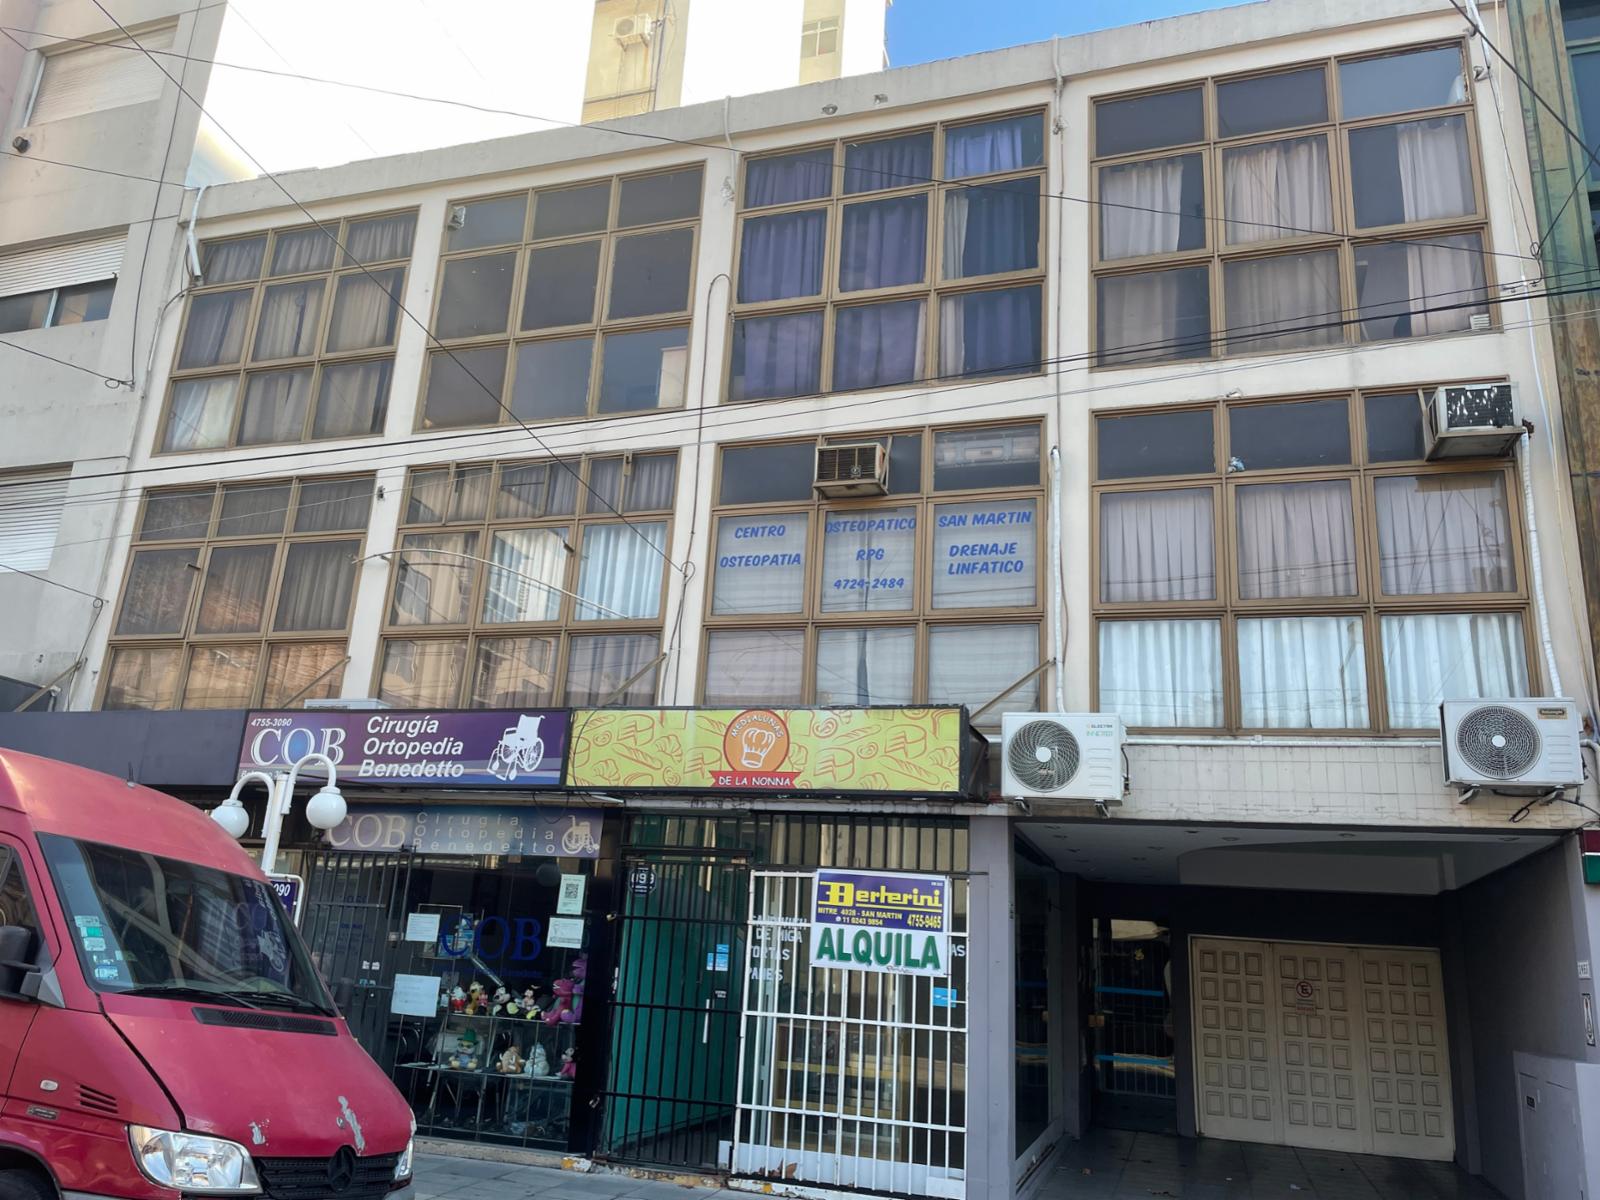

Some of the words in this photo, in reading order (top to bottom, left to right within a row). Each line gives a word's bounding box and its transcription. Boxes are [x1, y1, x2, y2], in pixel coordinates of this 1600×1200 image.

[735, 525, 785, 539] CENTRO
[825, 517, 916, 534] OSTEOPATICO
[938, 514, 967, 528] SAN
[972, 511, 1032, 526] MARTIN
[720, 553, 801, 568] OSTEOPATIA
[856, 549, 884, 561] RPG
[949, 542, 1018, 557] DRENAJE
[947, 560, 1024, 575] LINFATICO
[833, 577, 904, 590] 4724-2484
[251, 718, 292, 727] 4755-3090
[367, 715, 439, 738] Cirugía
[731, 715, 784, 738] MEDIALUNAS
[250, 727, 346, 767] COB
[363, 737, 464, 760] Ortopedia
[358, 759, 464, 778] Benedetto
[718, 776, 732, 786] DE
[735, 776, 748, 786] LA
[752, 777, 791, 786] NONNA
[326, 814, 406, 848] COB
[414, 824, 554, 840] Ortopedia
[412, 837, 556, 853] Benedetto
[818, 881, 943, 907] Berterini
[861, 910, 875, 918] SAN
[876, 911, 903, 920] MARTIN
[816, 927, 941, 970] ALQUILA
